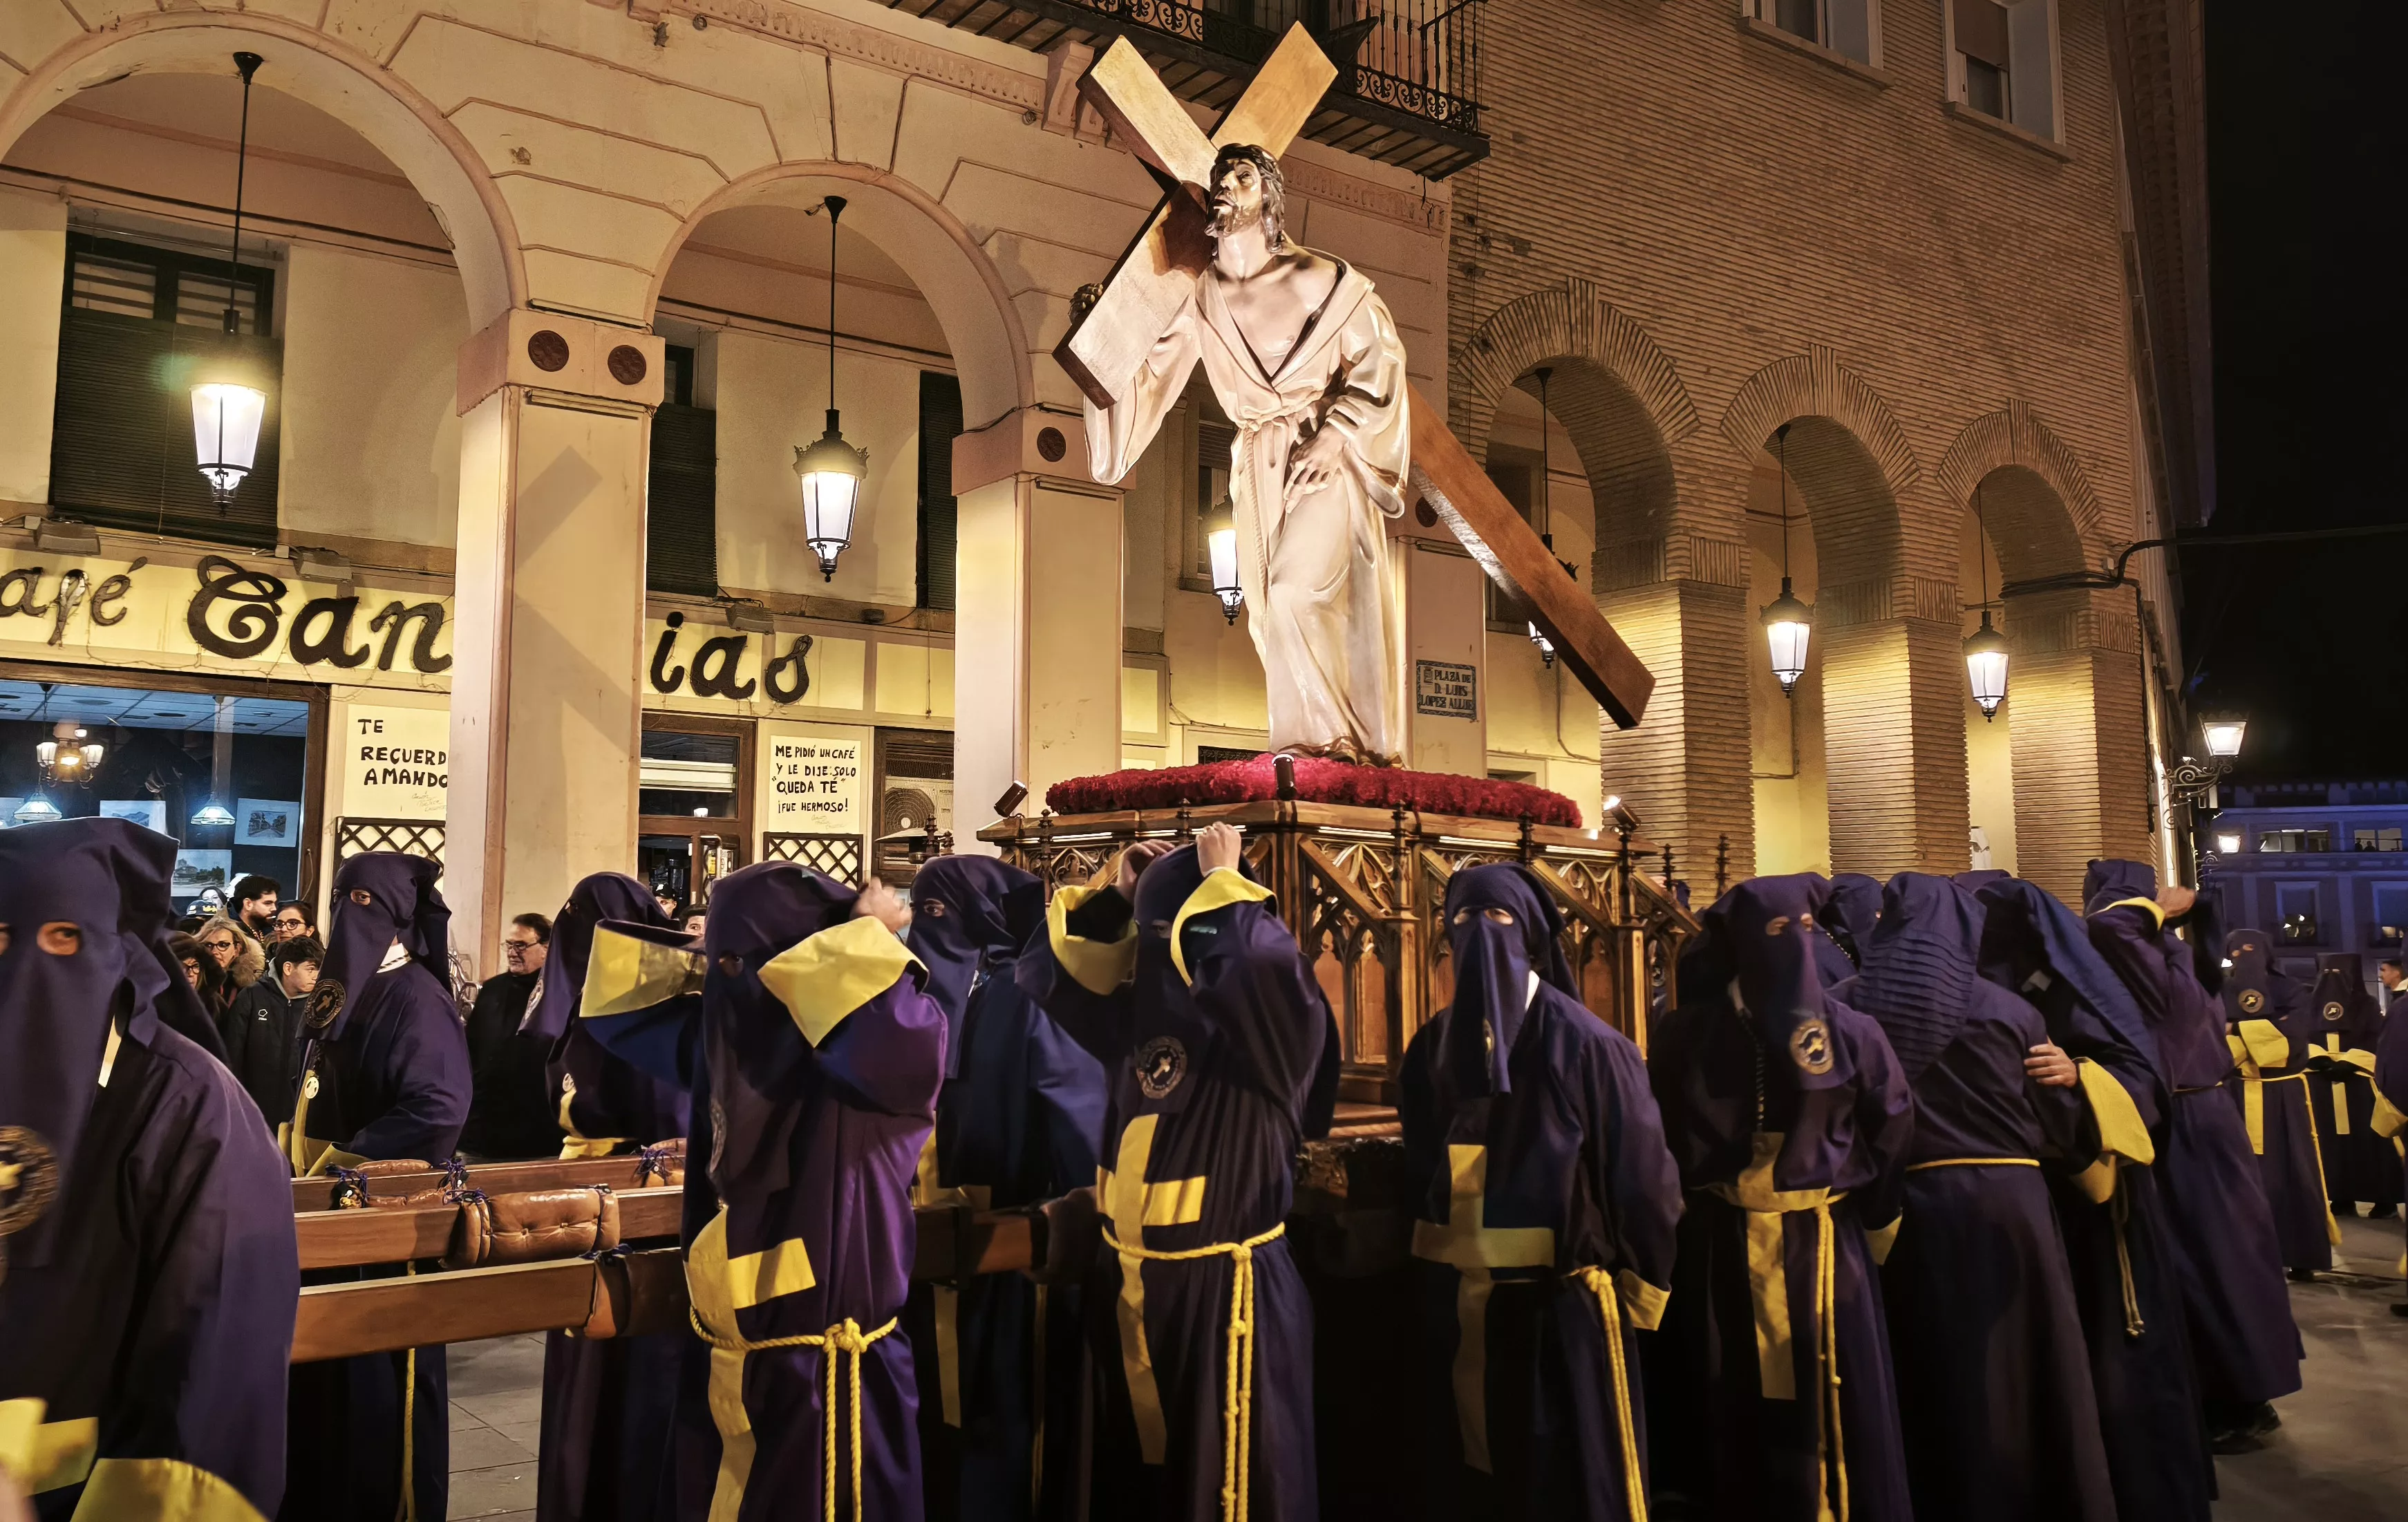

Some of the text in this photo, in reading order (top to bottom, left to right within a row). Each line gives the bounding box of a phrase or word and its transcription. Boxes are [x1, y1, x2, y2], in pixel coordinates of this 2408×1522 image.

[0, 556, 148, 646] afé
[1434, 669, 1460, 682] PLAZA
[357, 719, 384, 734] TE
[361, 746, 446, 765] RECUERD
[775, 745, 856, 759] ME PIDIÓ UN CAFÉ
[776, 763, 783, 775] Y
[789, 764, 798, 775] LE
[832, 766, 856, 777] SOLO
[801, 798, 848, 812] HERMOSO!
